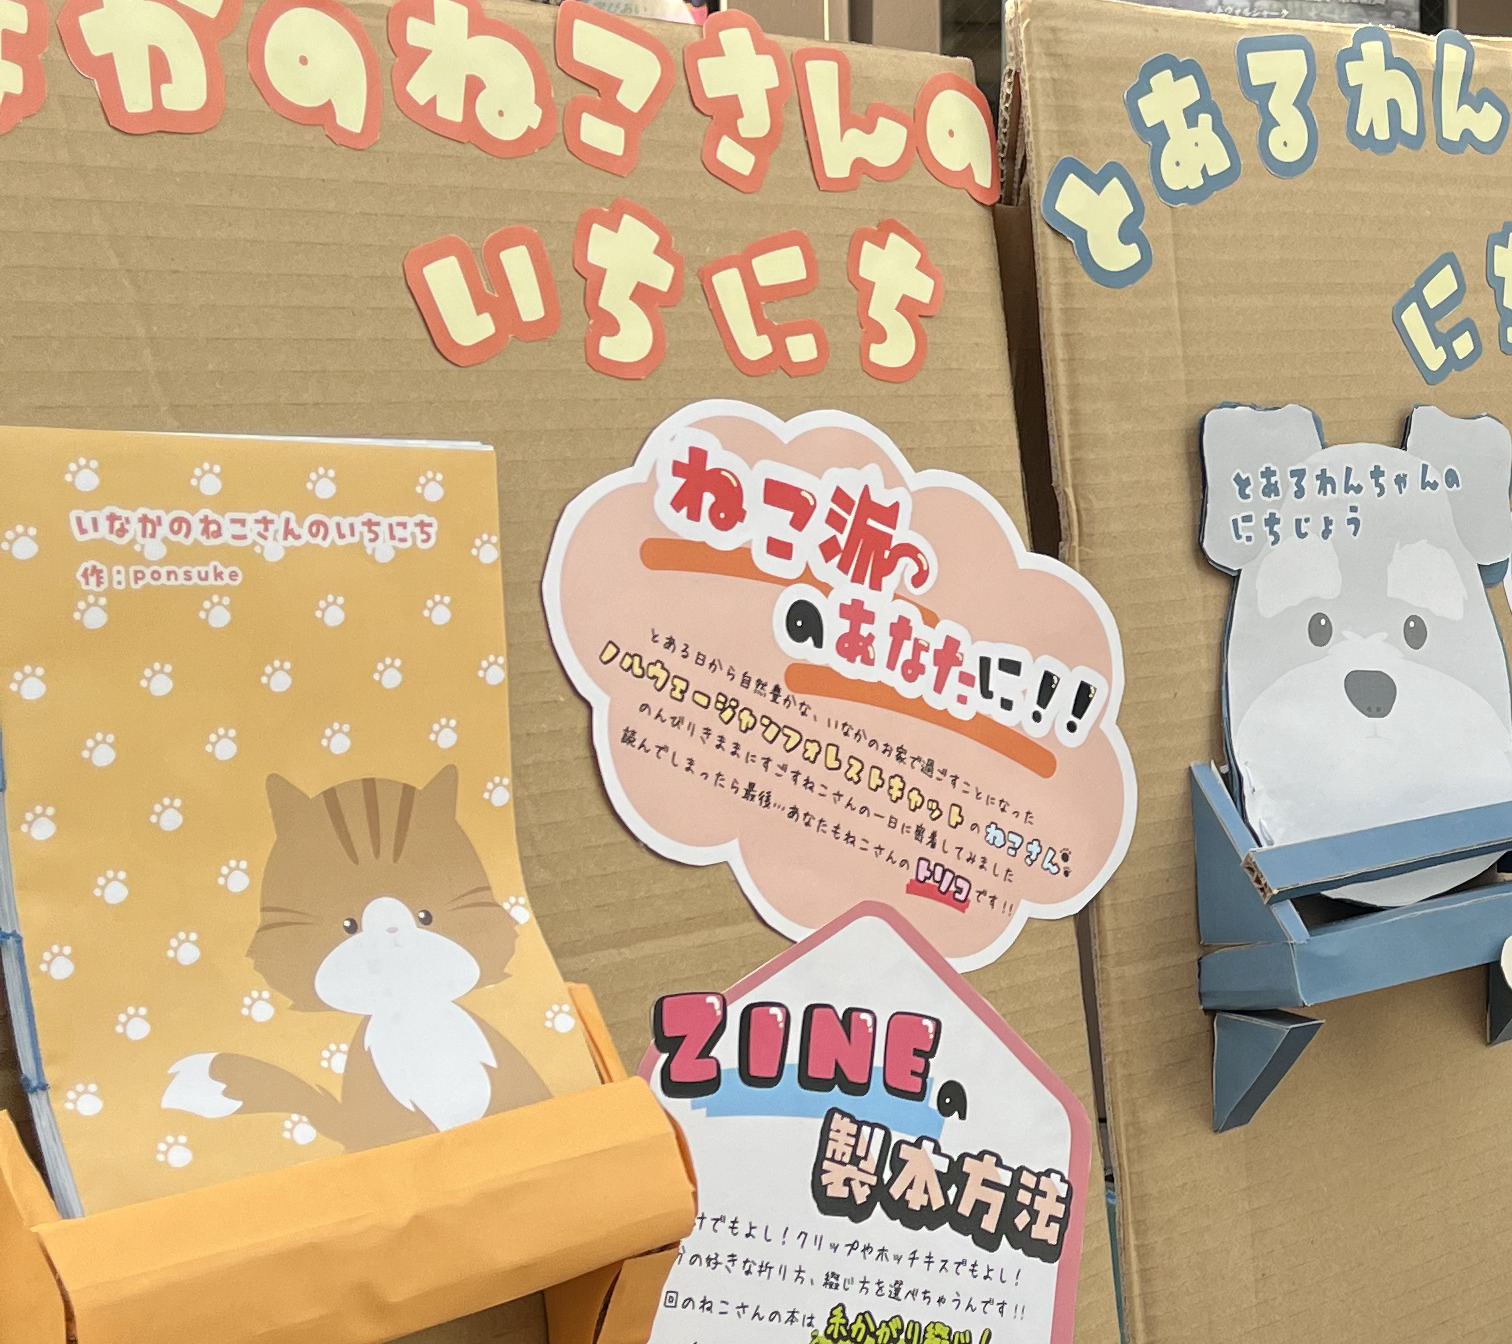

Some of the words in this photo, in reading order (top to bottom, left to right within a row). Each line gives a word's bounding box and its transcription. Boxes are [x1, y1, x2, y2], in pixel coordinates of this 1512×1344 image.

[404, 198, 944, 382] いちにち
[70, 505, 438, 550] いなかのねこさんのいちにち
[669, 444, 931, 593] ねこ派
[1231, 504, 1362, 546] にちじょう
[1232, 462, 1462, 501] とあるわんちゃんの
[649, 626, 1036, 828] とある日から自然豊かな、いなかのお家で過ごすことになった
[784, 596, 1099, 734] のあなたに!!
[598, 640, 1060, 877] ノルウェージャンフォレストキャットのねこさん
[637, 700, 1016, 884] のんびりきままにすごすねこさんの一日に密着してみました
[653, 991, 968, 1121] ZINEの
[811, 1106, 1073, 1262] 製本方法
[663, 1289, 816, 1330] 回のねこさんの本は
